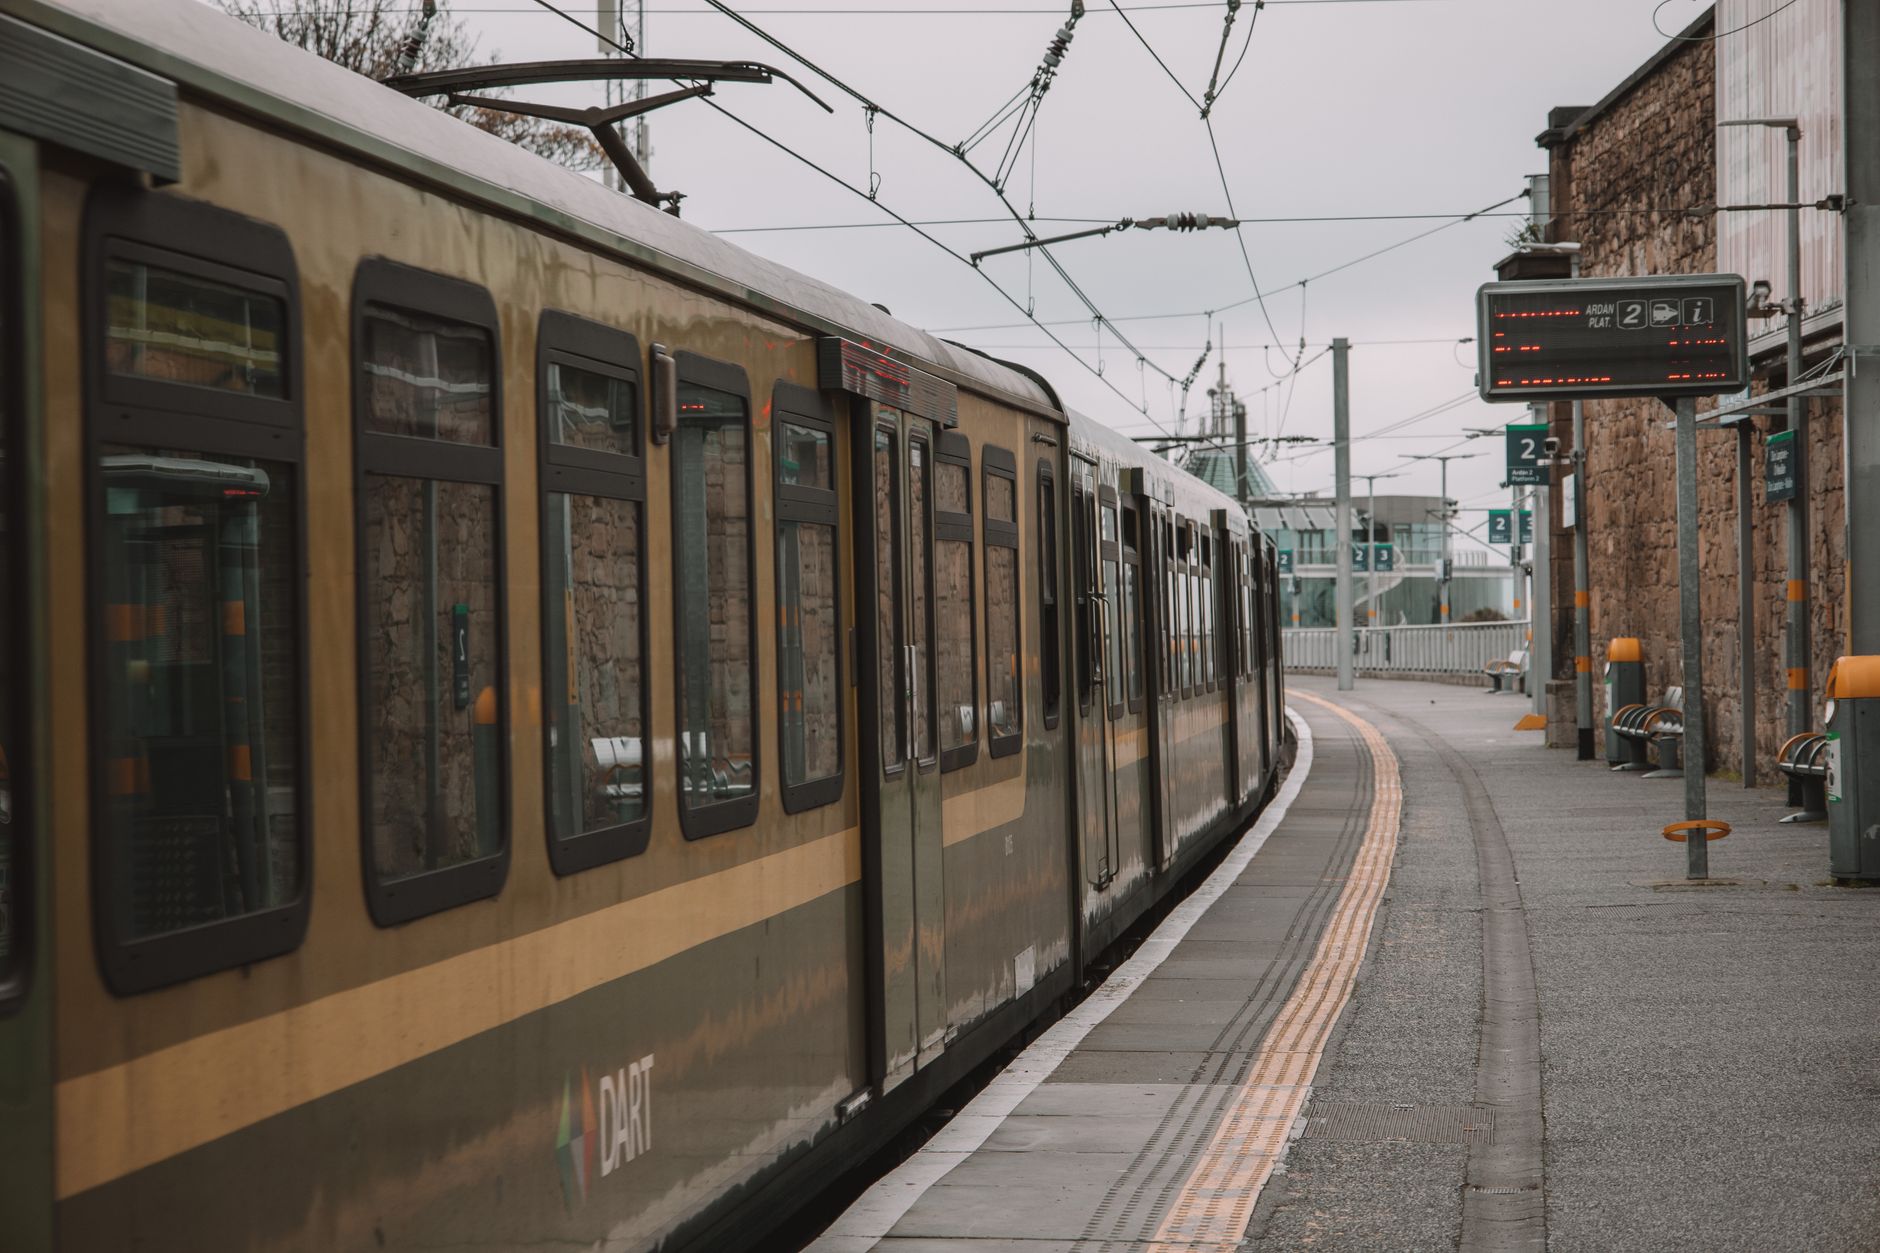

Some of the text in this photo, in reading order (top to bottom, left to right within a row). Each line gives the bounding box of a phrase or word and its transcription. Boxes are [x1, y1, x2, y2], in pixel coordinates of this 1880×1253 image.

[1623, 304, 1642, 324] 2
[1588, 316, 1612, 328] PLAT.
[1520, 438, 1536, 459] 2
[1496, 517, 1506, 530] 2
[1280, 554, 1288, 565] 2
[1355, 550, 1364, 561] 2
[1380, 550, 1388, 561] 3
[600, 1053, 655, 1177] DART
